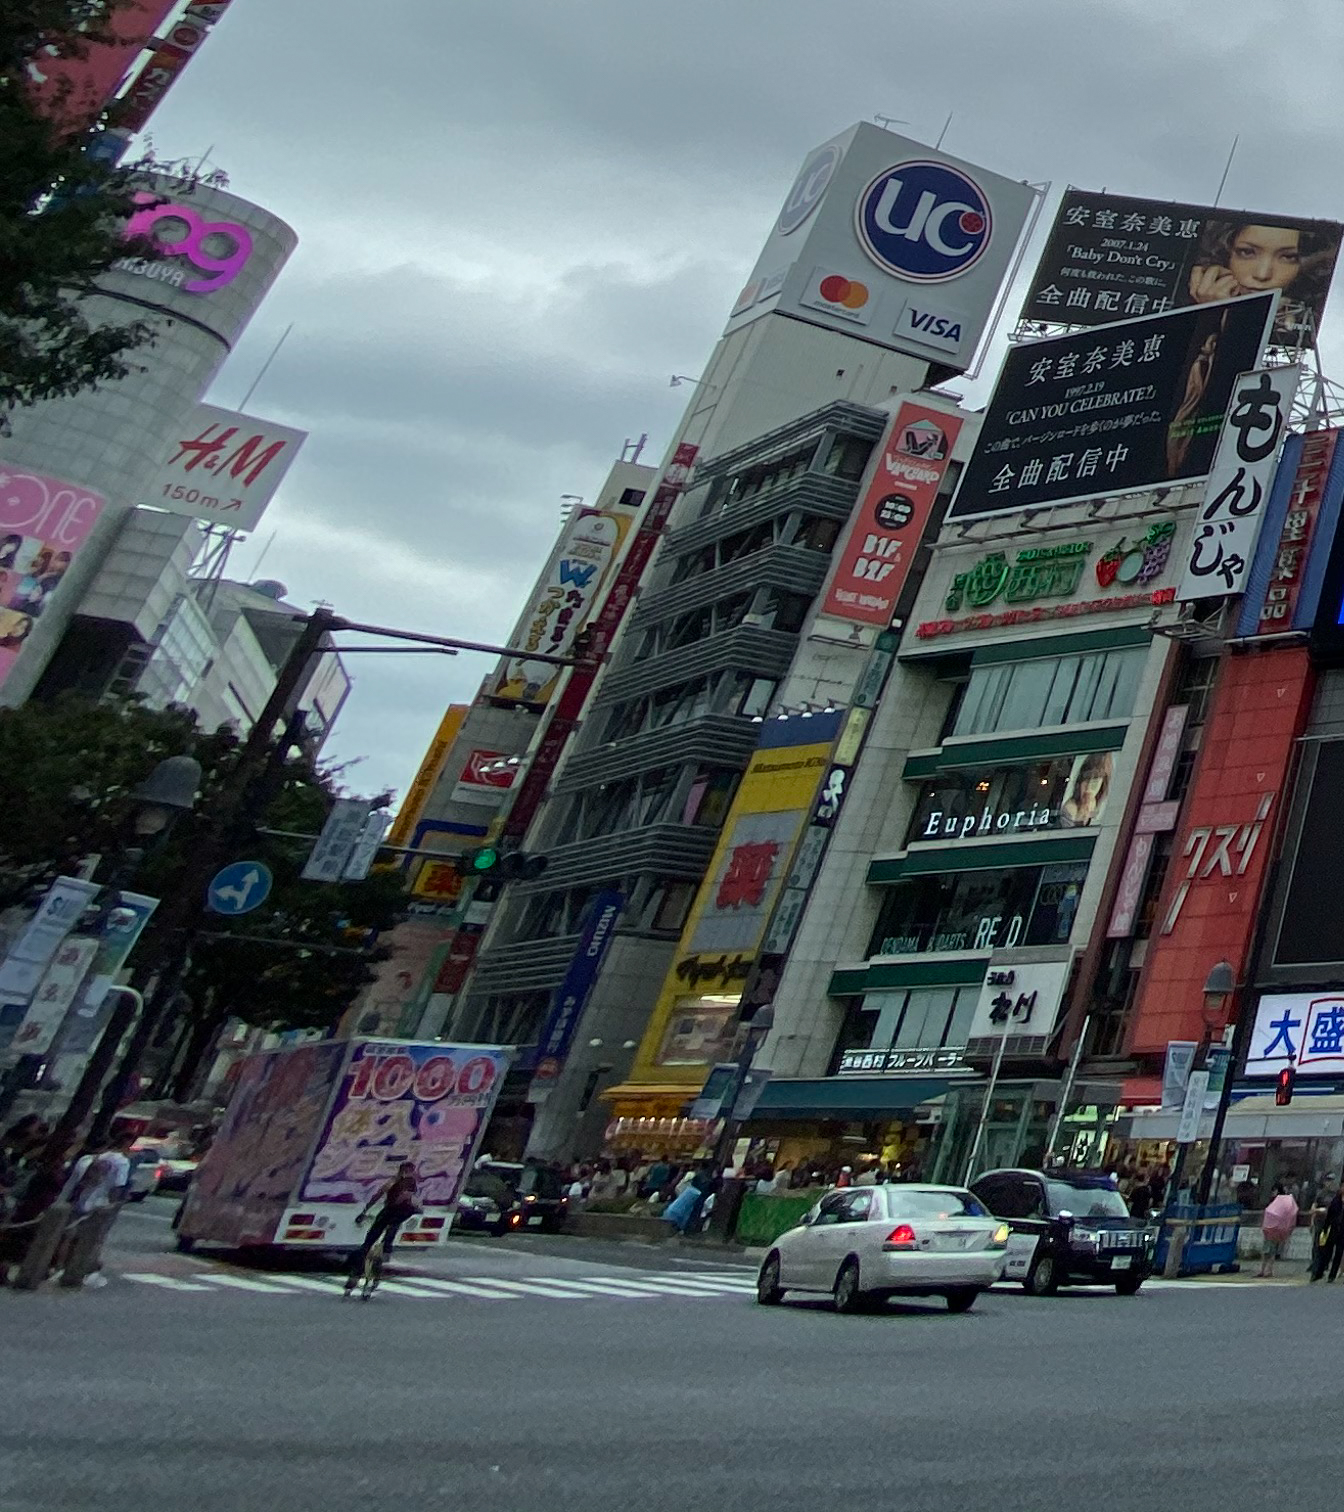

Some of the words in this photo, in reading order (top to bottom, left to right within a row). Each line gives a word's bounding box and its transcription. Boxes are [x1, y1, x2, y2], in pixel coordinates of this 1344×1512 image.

[874, 177, 986, 257] UC
[1062, 205, 1201, 239] 安室奈美恵
[126, 192, 253, 293] 09
[1100, 237, 1150, 253] 2007.1.24
[1106, 250, 1142, 266] Don't
[1036, 283, 1176, 315] 全曲配信中
[908, 307, 962, 343] VISA
[1024, 333, 1165, 387] 安室奈美恵
[1039, 402, 1069, 420] YOU
[168, 422, 287, 488] H&M
[988, 443, 1130, 494] 全曲配信中
[161, 482, 221, 510] 150m
[1189, 373, 1283, 589] もんじゃ
[862, 534, 902, 559] B1F
[852, 557, 895, 583] B2F
[924, 800, 1051, 839] Euphoria
[348, 1054, 497, 1102] 1000
